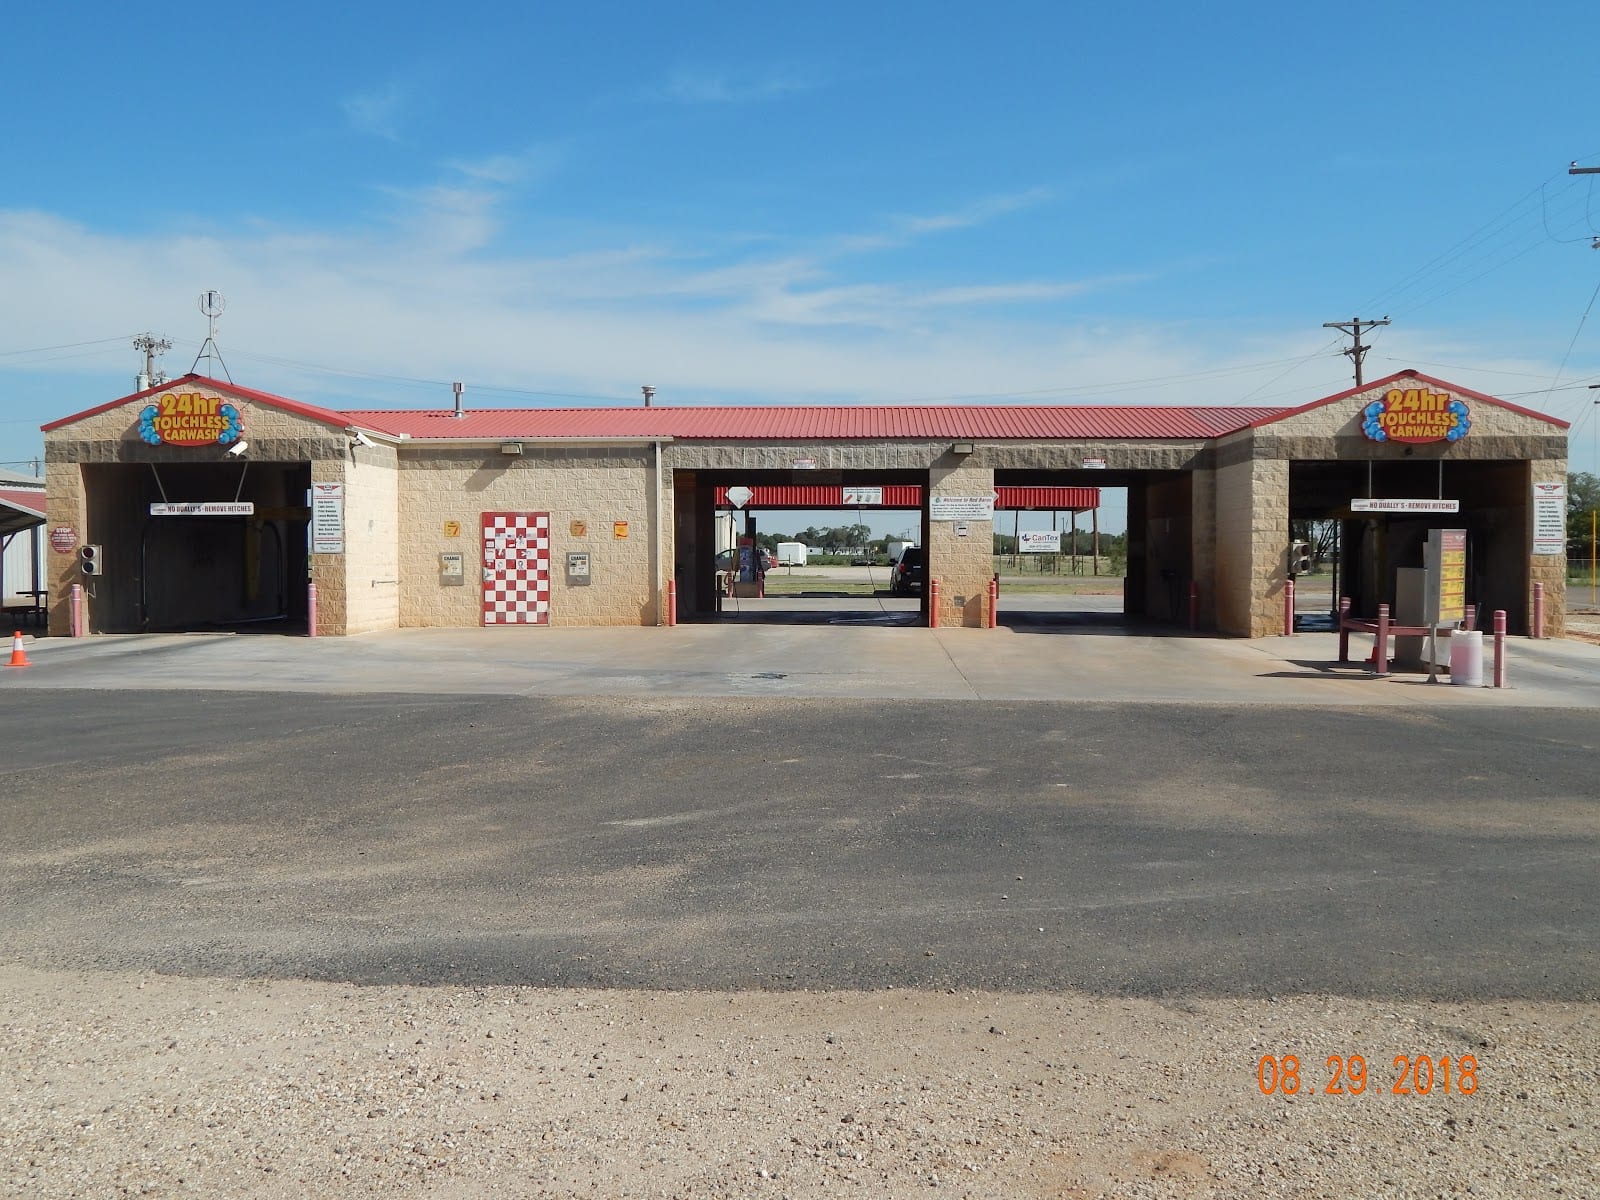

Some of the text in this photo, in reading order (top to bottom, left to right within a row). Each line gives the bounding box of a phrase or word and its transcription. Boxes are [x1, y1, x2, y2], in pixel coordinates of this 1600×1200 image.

[161, 393, 220, 415] 24hr
[1387, 389, 1449, 411] 24hr
[153, 416, 229, 431] TOUCHLESS
[1379, 412, 1458, 427] TOUCHLESS
[164, 429, 219, 441] CARWASH
[1389, 425, 1448, 437] CARWASH
[204, 505, 227, 513] REMOVE
